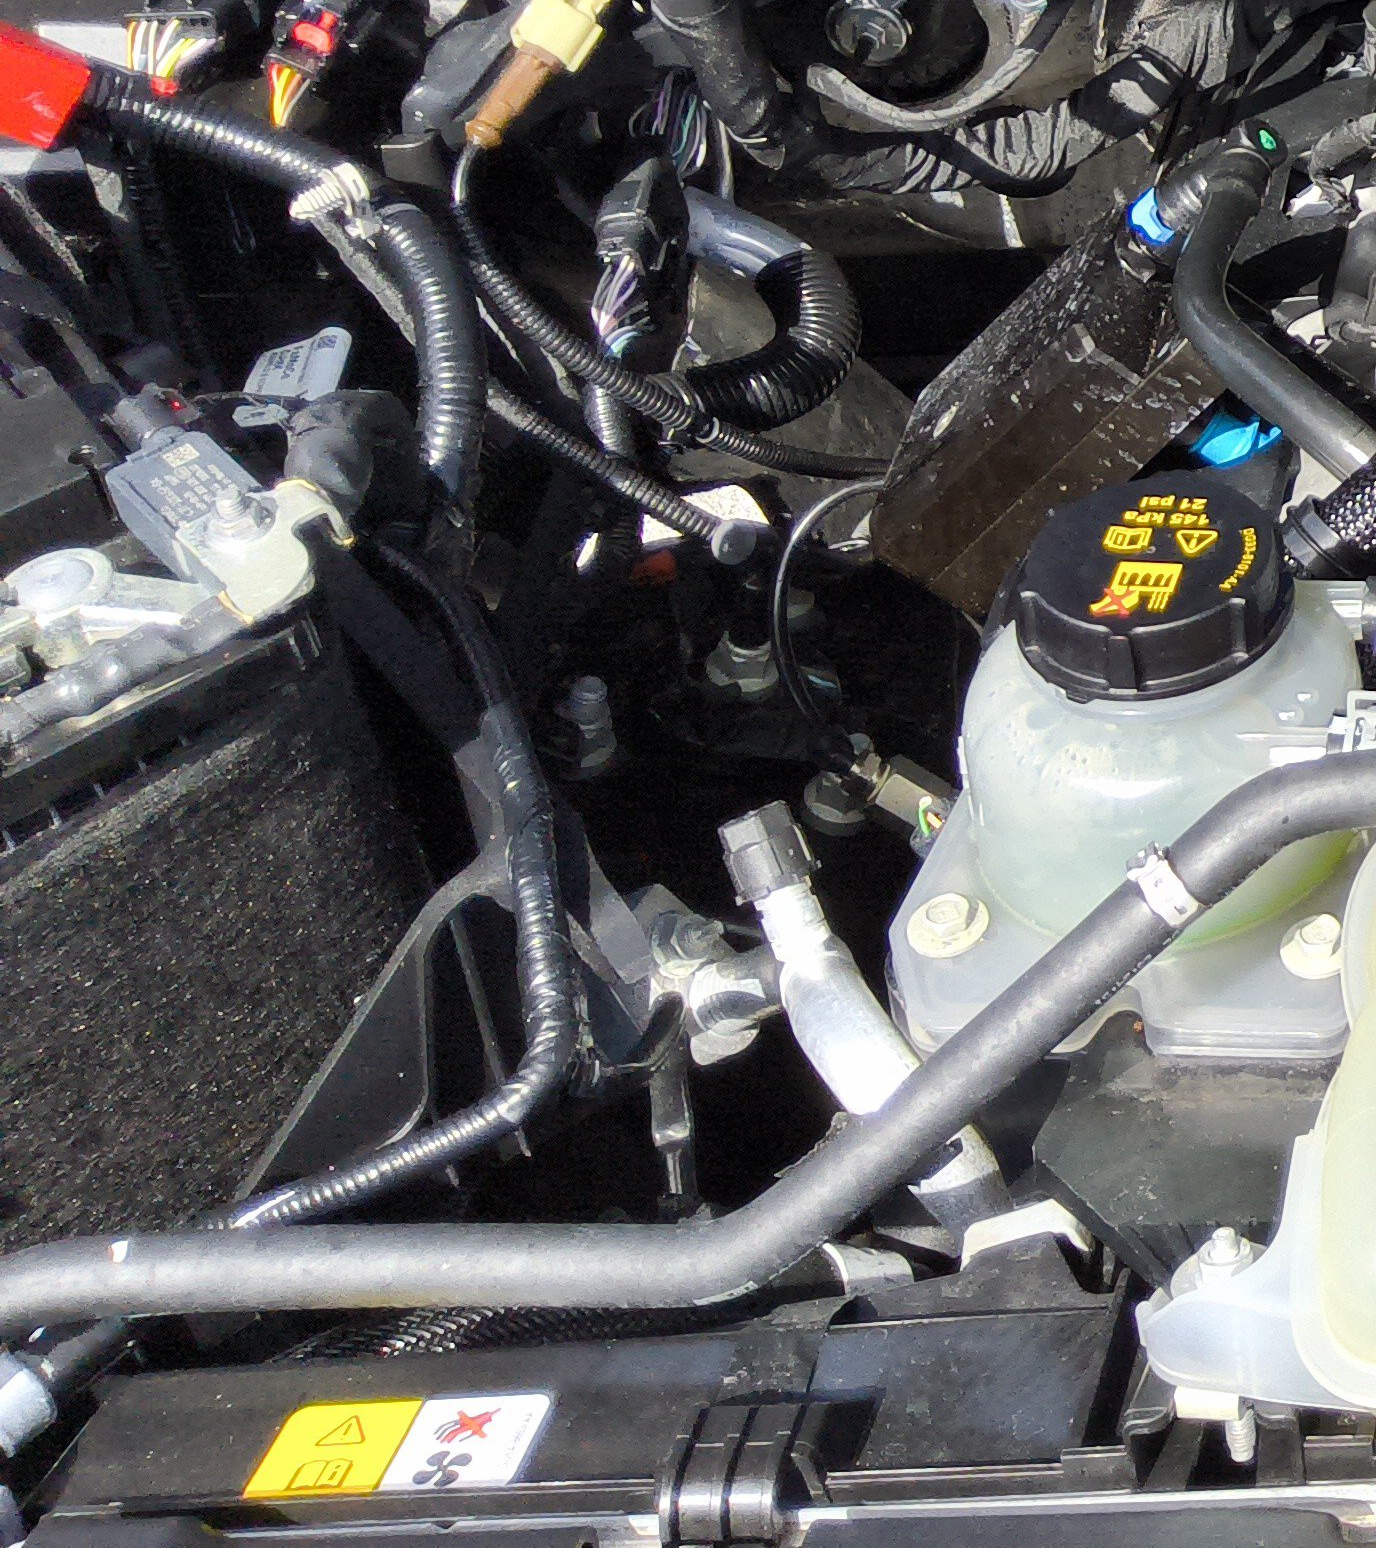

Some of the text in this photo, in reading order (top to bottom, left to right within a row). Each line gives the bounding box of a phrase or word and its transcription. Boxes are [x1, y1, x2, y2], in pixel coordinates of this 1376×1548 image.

[1139, 494, 1208, 513] 21 psi
[1122, 510, 1210, 528] 145 kPa
